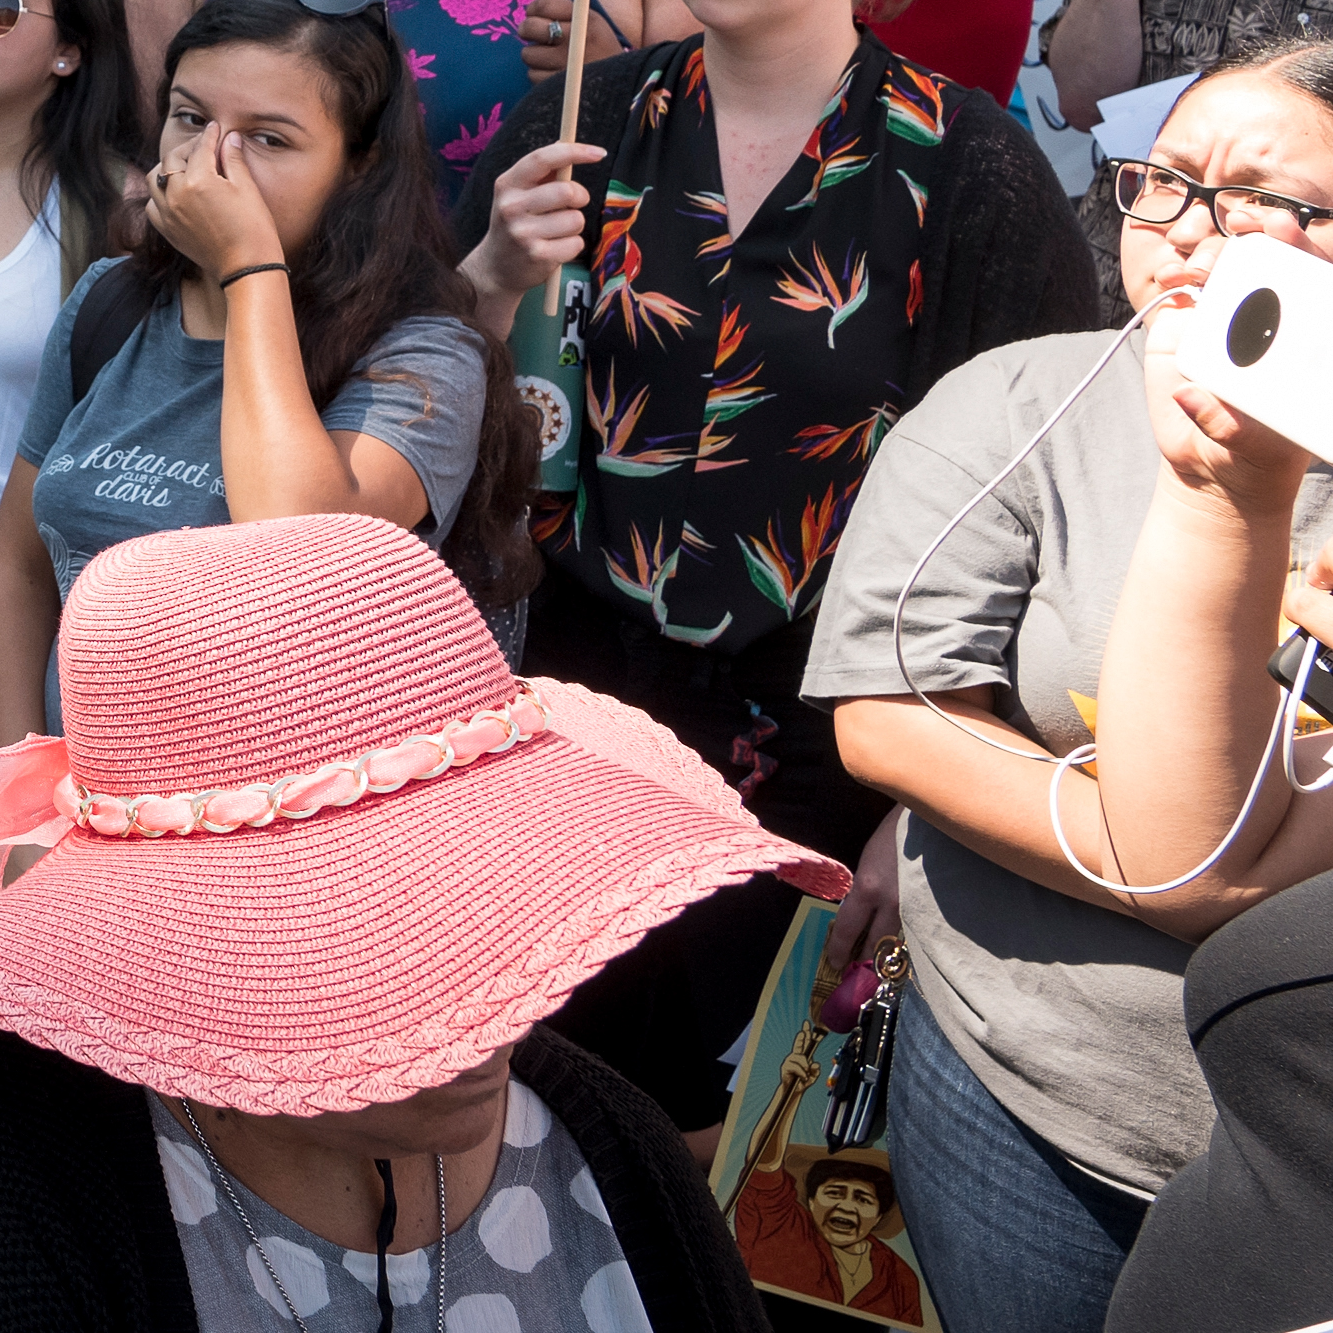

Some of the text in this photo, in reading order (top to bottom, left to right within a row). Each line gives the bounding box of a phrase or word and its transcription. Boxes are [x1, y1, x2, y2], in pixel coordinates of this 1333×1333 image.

[80, 443, 210, 488] Rotaract
[123, 471, 163, 485] CLUB OF
